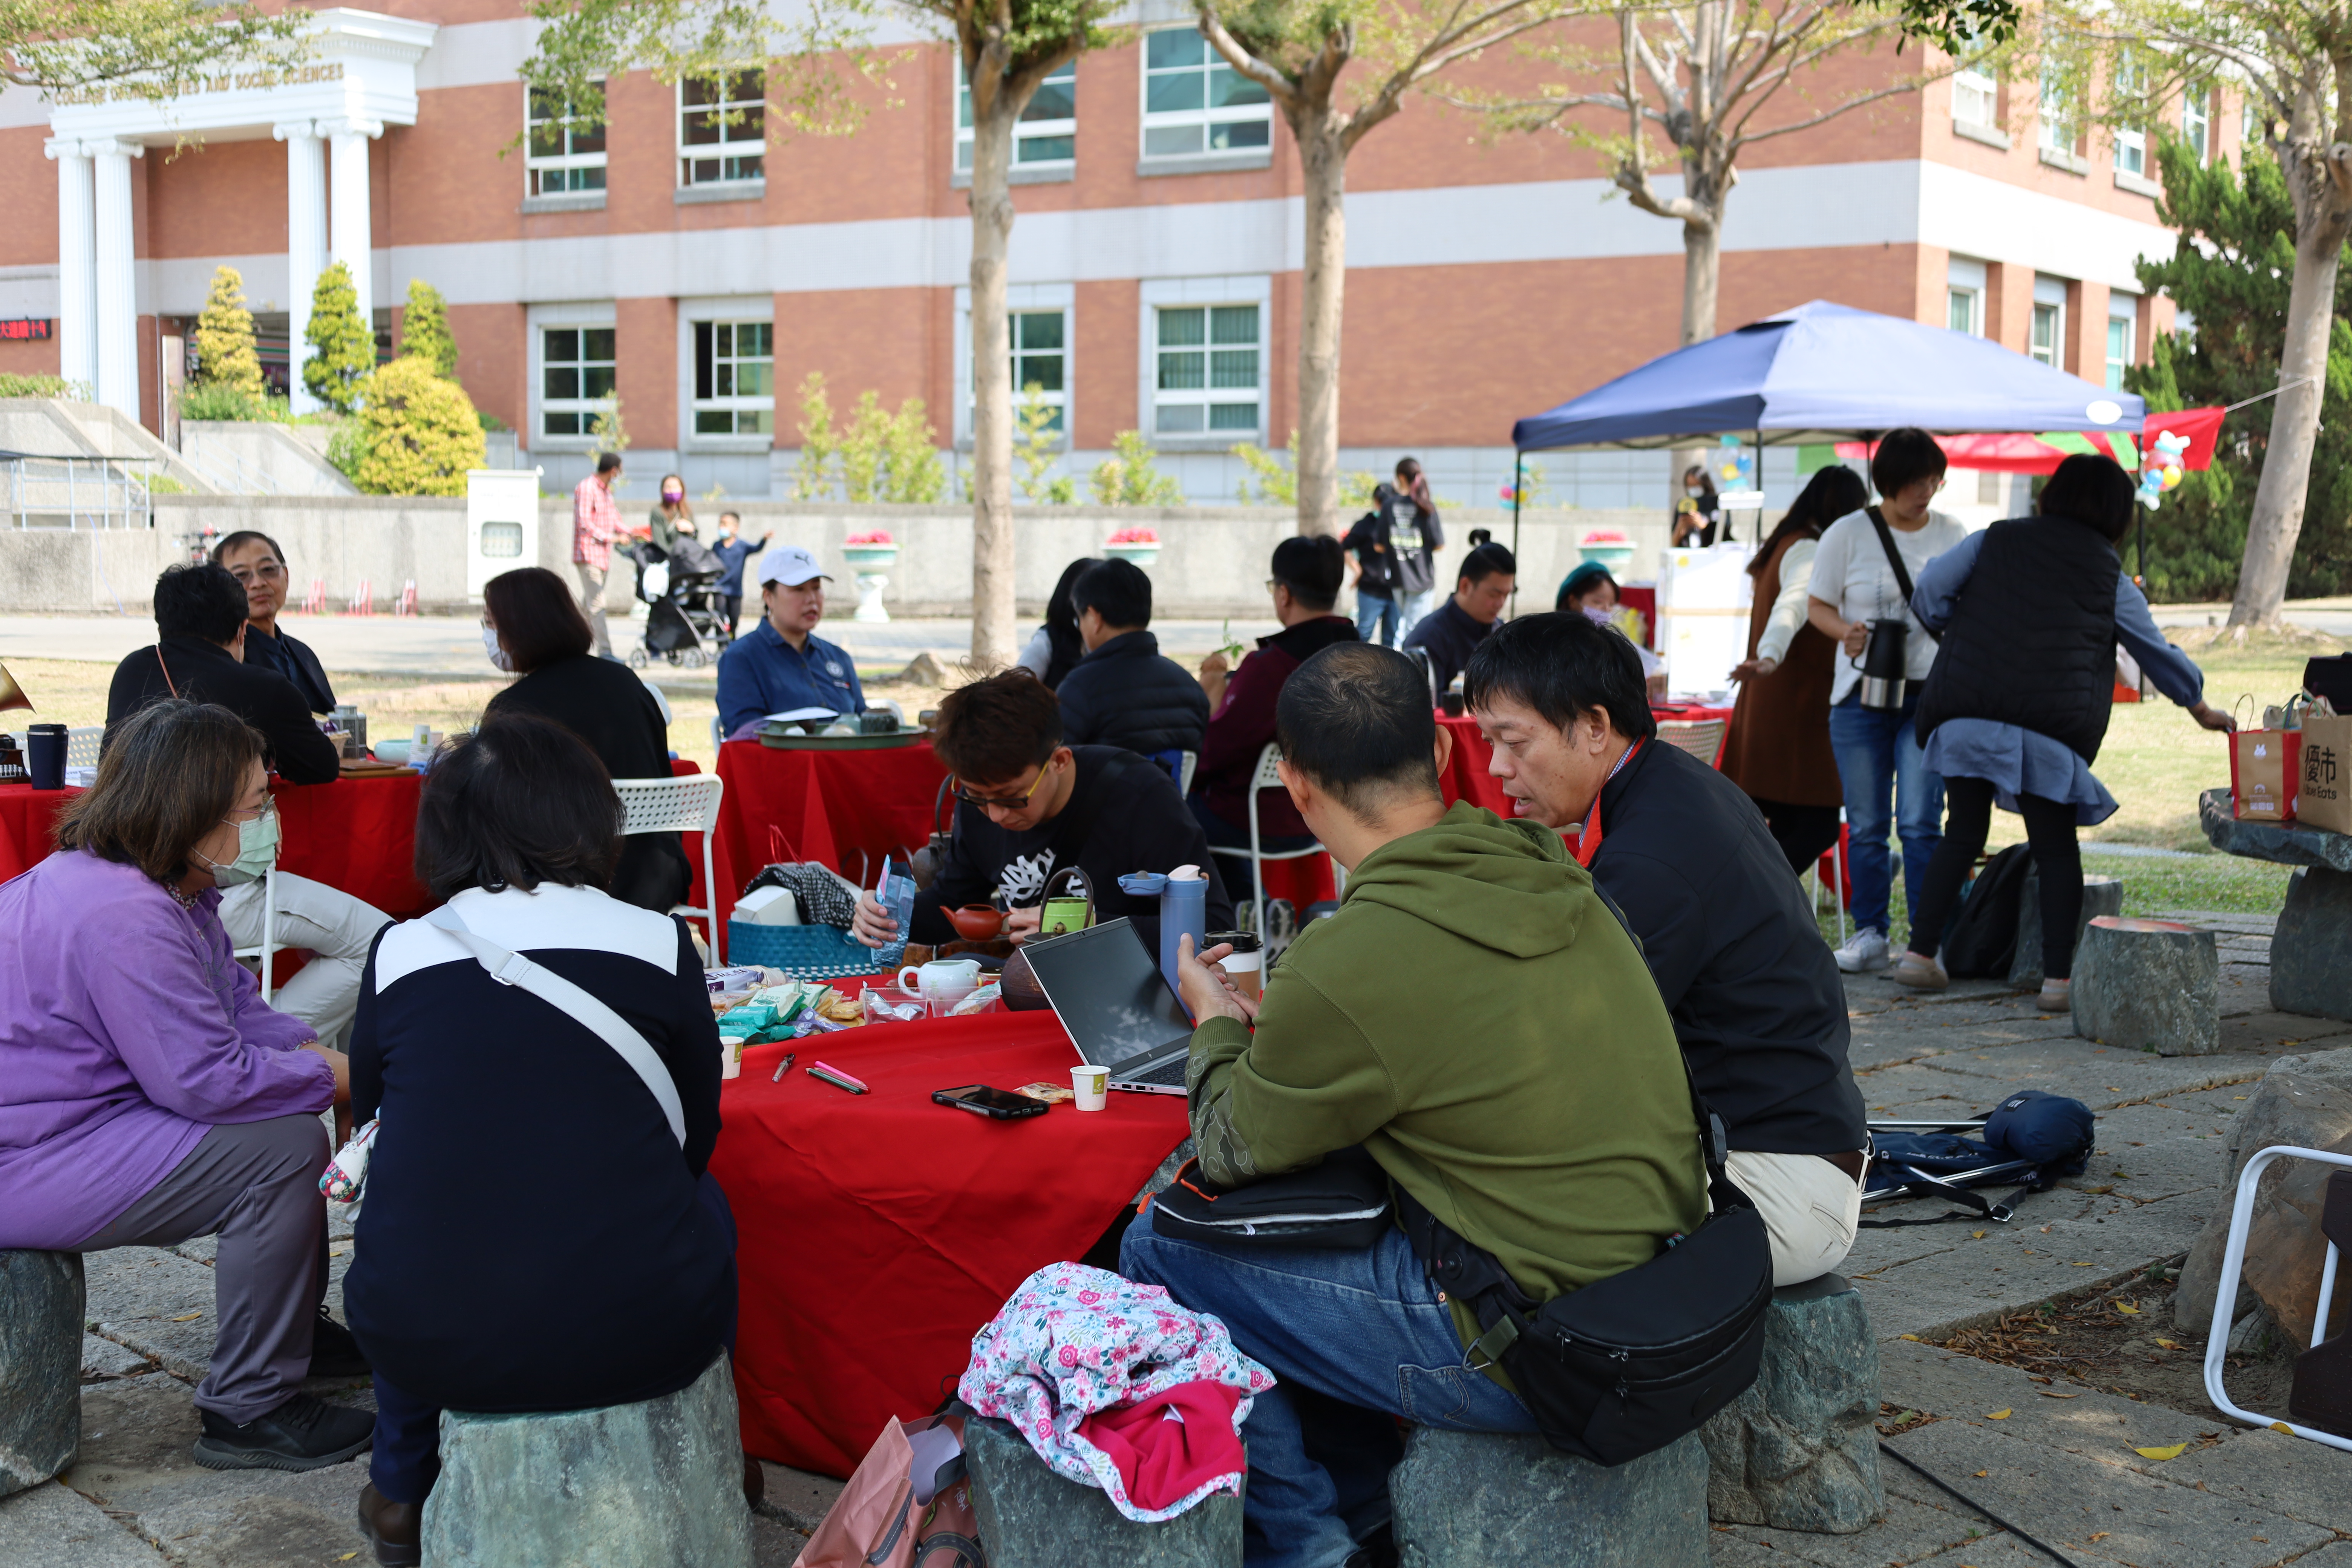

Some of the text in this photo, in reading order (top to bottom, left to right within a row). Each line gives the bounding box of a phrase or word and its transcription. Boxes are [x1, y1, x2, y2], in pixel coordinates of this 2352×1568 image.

[283, 63, 344, 85] SCIENCES
[2305, 744, 2336, 784] 優市
[2318, 786, 2337, 799] Eats
